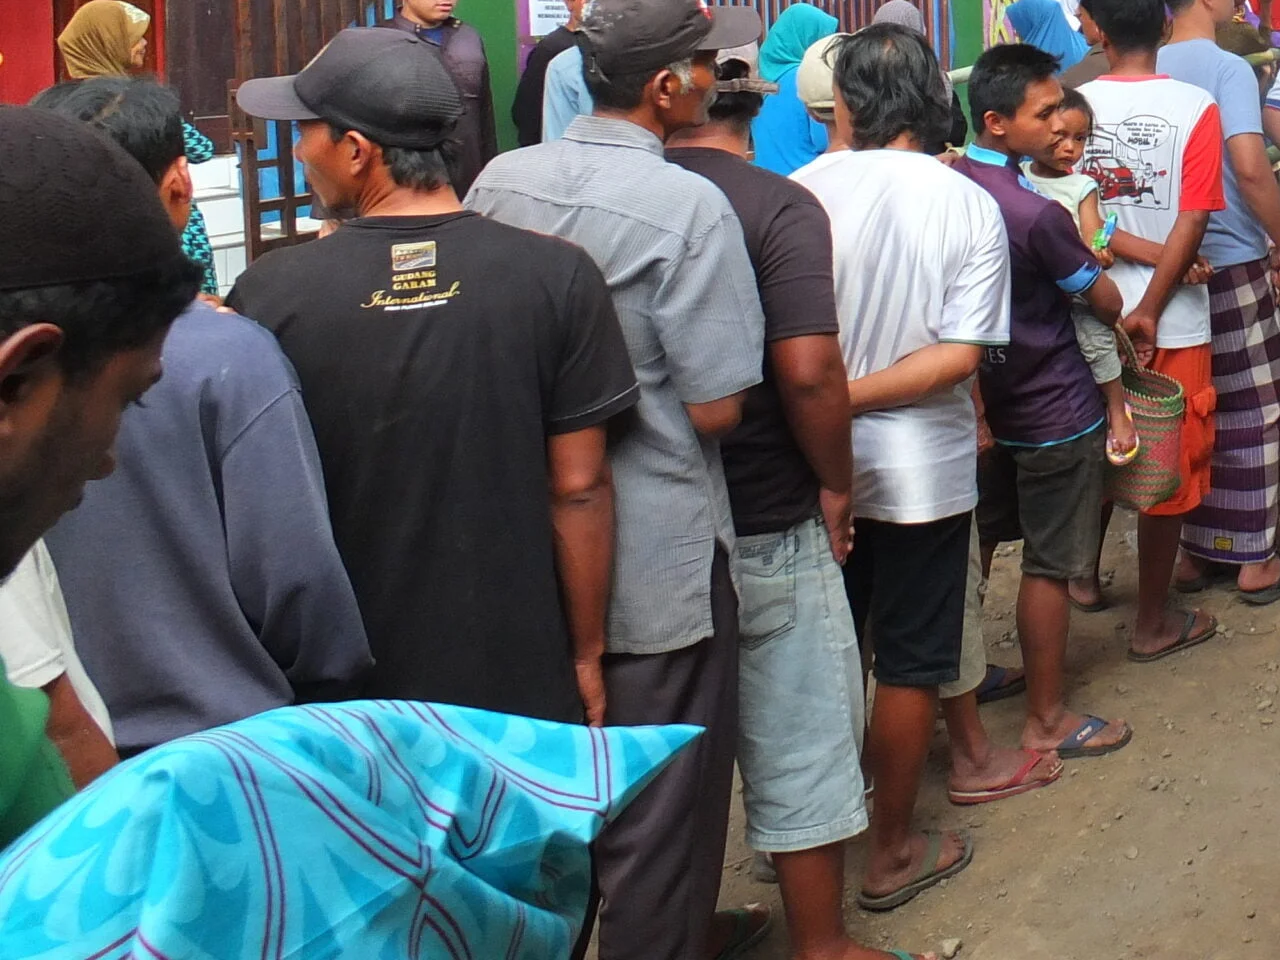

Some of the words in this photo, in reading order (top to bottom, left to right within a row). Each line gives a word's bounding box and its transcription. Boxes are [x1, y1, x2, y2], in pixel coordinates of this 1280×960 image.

[392, 270, 436, 281] GUDANG
[392, 279, 436, 291] GARAM
[360, 281, 460, 308] International
